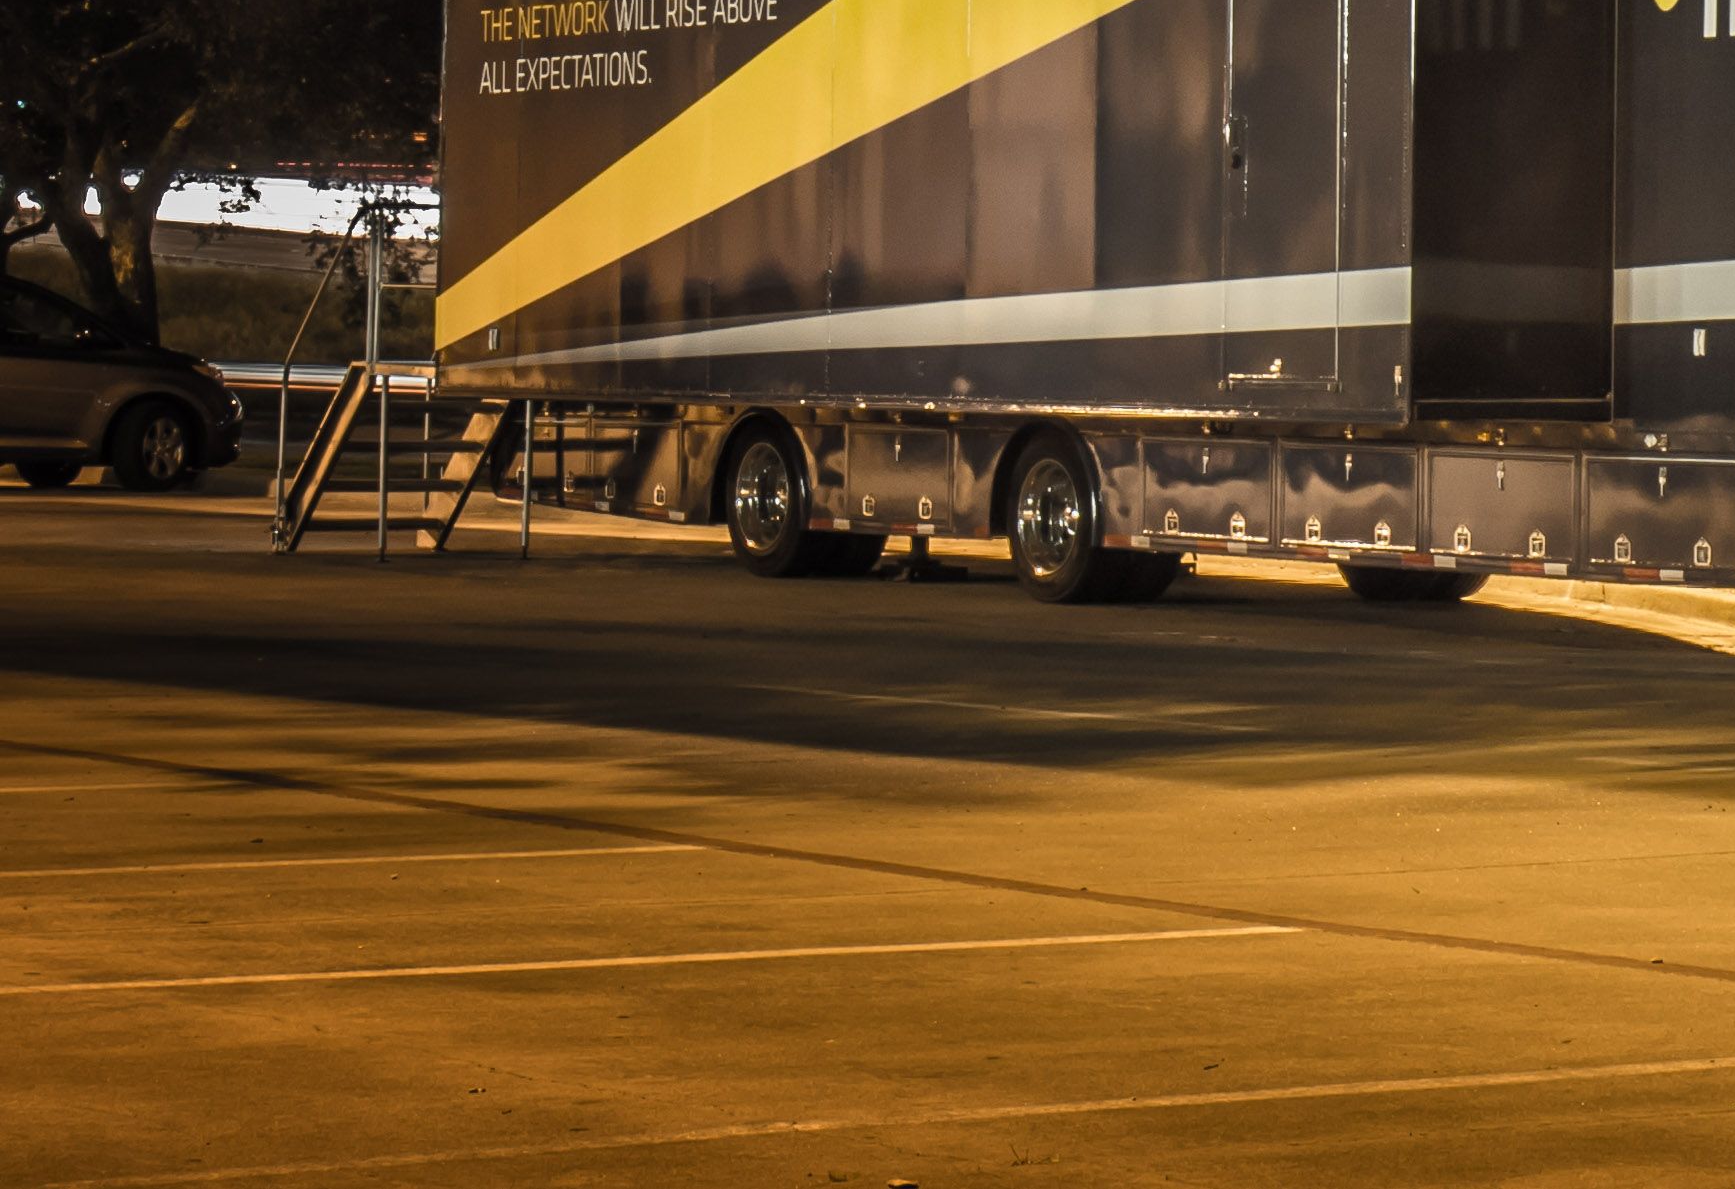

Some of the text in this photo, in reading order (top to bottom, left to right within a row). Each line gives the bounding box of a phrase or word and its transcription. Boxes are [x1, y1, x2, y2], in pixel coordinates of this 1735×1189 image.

[480, 7, 513, 43] THE
[517, 0, 610, 39] NETWORK
[479, 49, 652, 94] ALL EXPECTATIONS.
